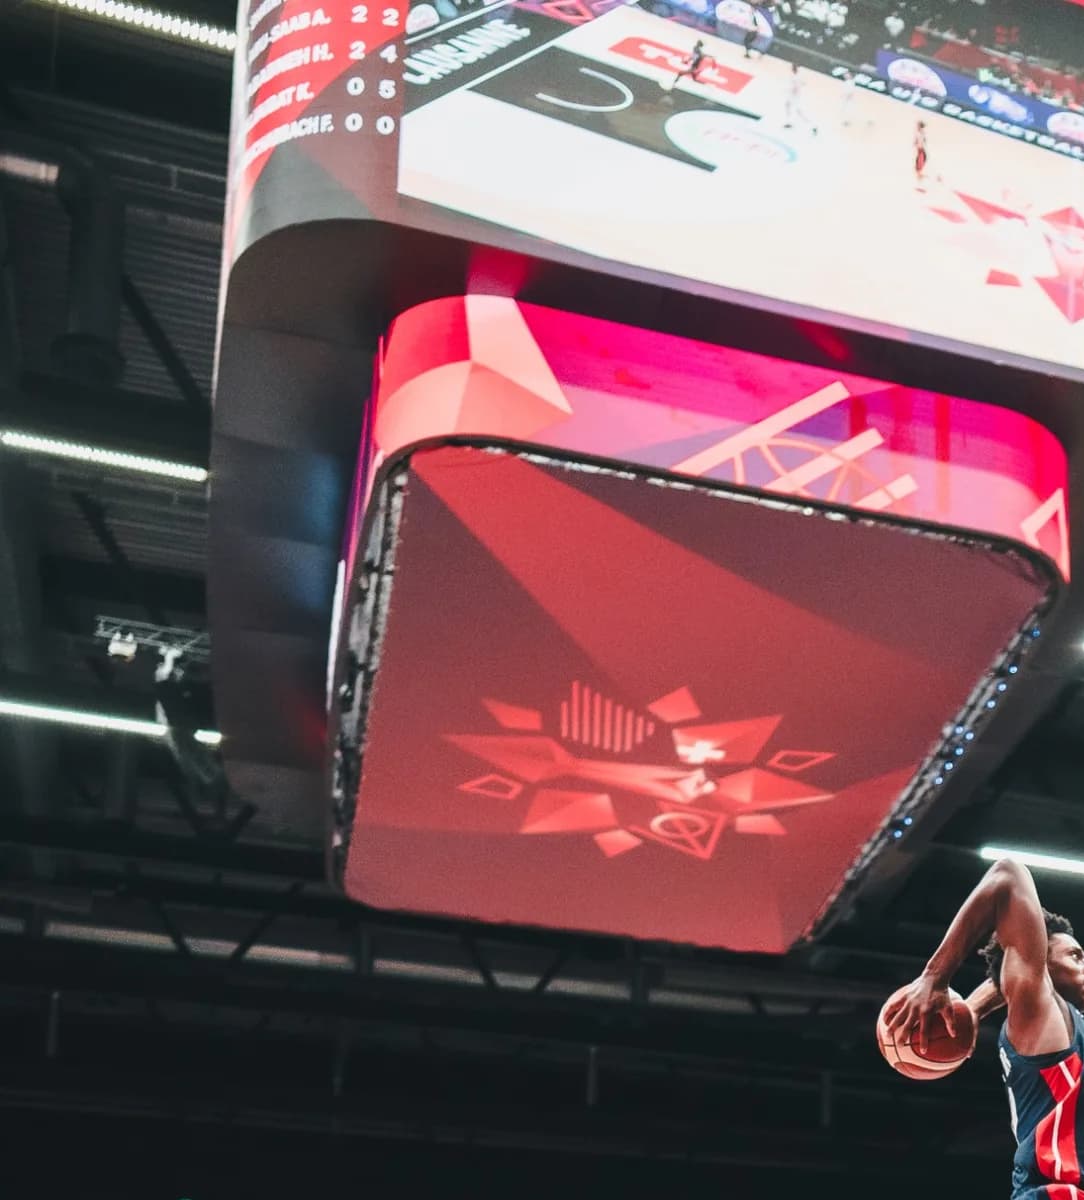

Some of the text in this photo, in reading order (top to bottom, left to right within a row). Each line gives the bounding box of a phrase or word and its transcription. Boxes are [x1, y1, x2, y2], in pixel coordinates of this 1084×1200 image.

[351, 5, 368, 23] 2
[382, 8, 399, 27] 2
[348, 40, 366, 59] 2
[379, 44, 398, 63] 4
[346, 77, 365, 96] 0
[378, 79, 396, 99] 5
[344, 112, 363, 132] 0
[376, 115, 395, 135] 0
